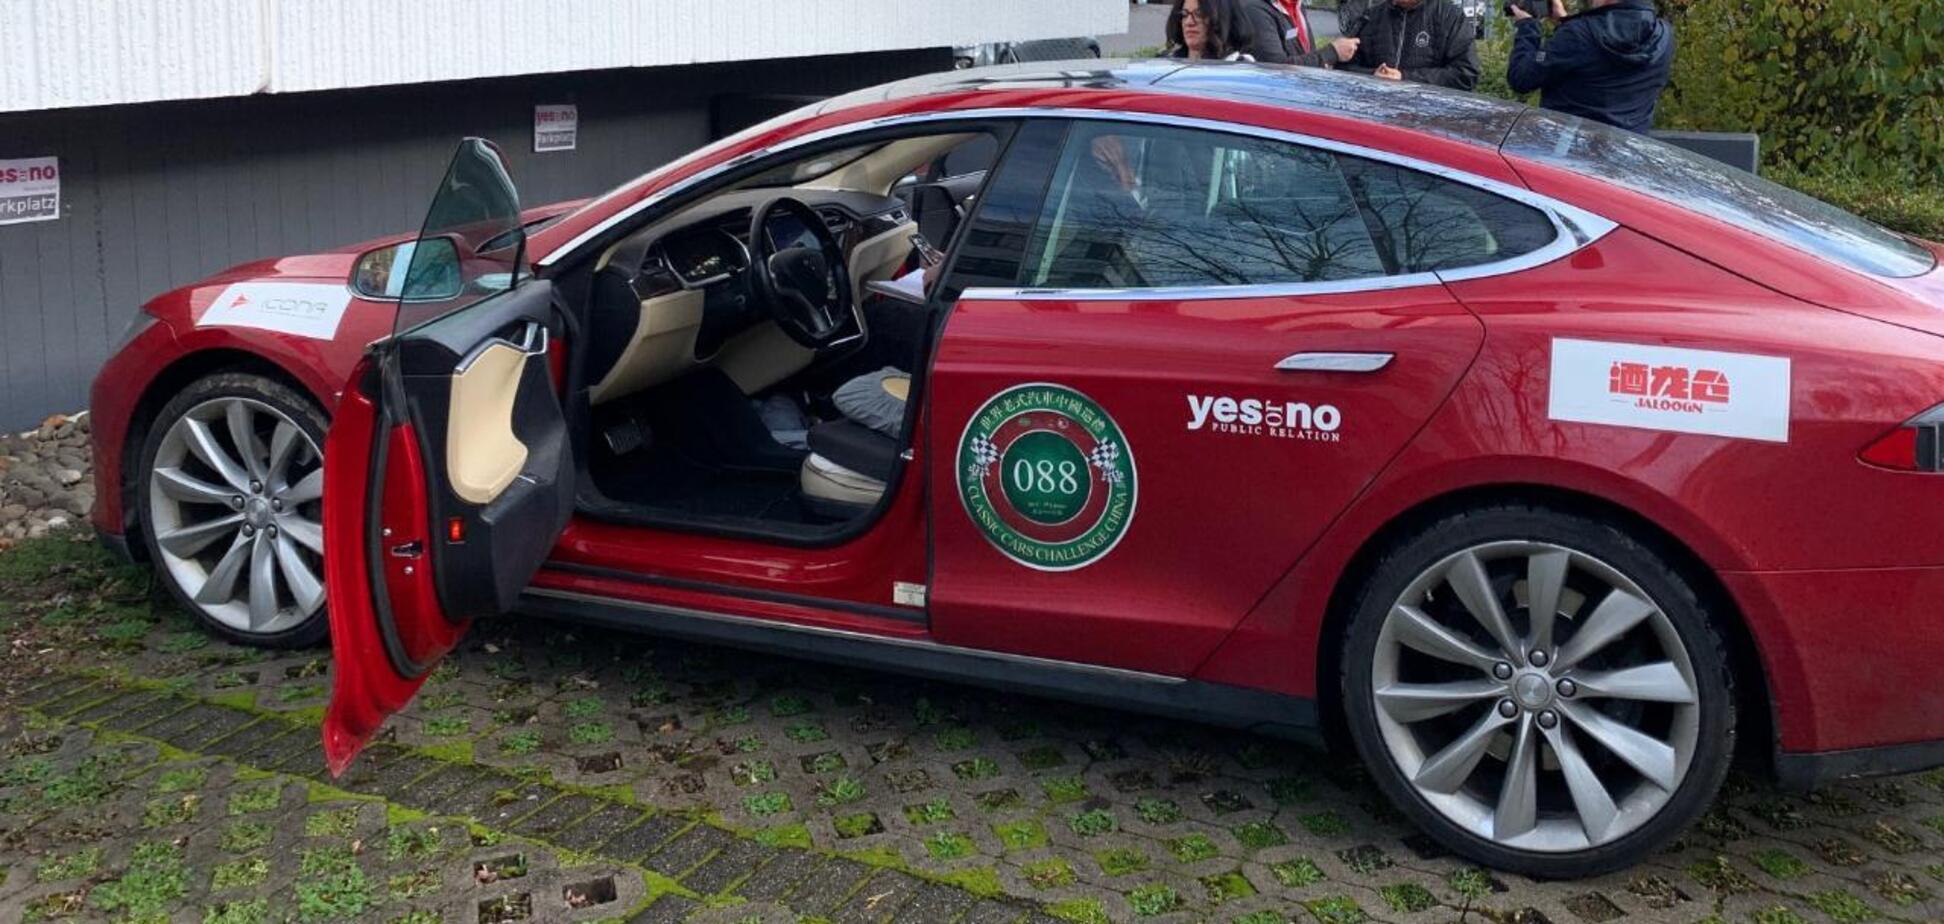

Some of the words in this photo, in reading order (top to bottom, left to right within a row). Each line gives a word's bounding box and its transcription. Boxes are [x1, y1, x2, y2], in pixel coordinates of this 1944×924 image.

[1634, 398, 1704, 414] JALOOGN
[1212, 422, 1263, 436] PUBLIC
[1270, 428, 1341, 442] RELATION
[1013, 459, 1078, 494] 088
[967, 485, 1001, 536] CLASSIC
[1000, 532, 1035, 558] CARS
[1035, 529, 1111, 562] CHALLENGE
[1105, 491, 1129, 533] CHINA
